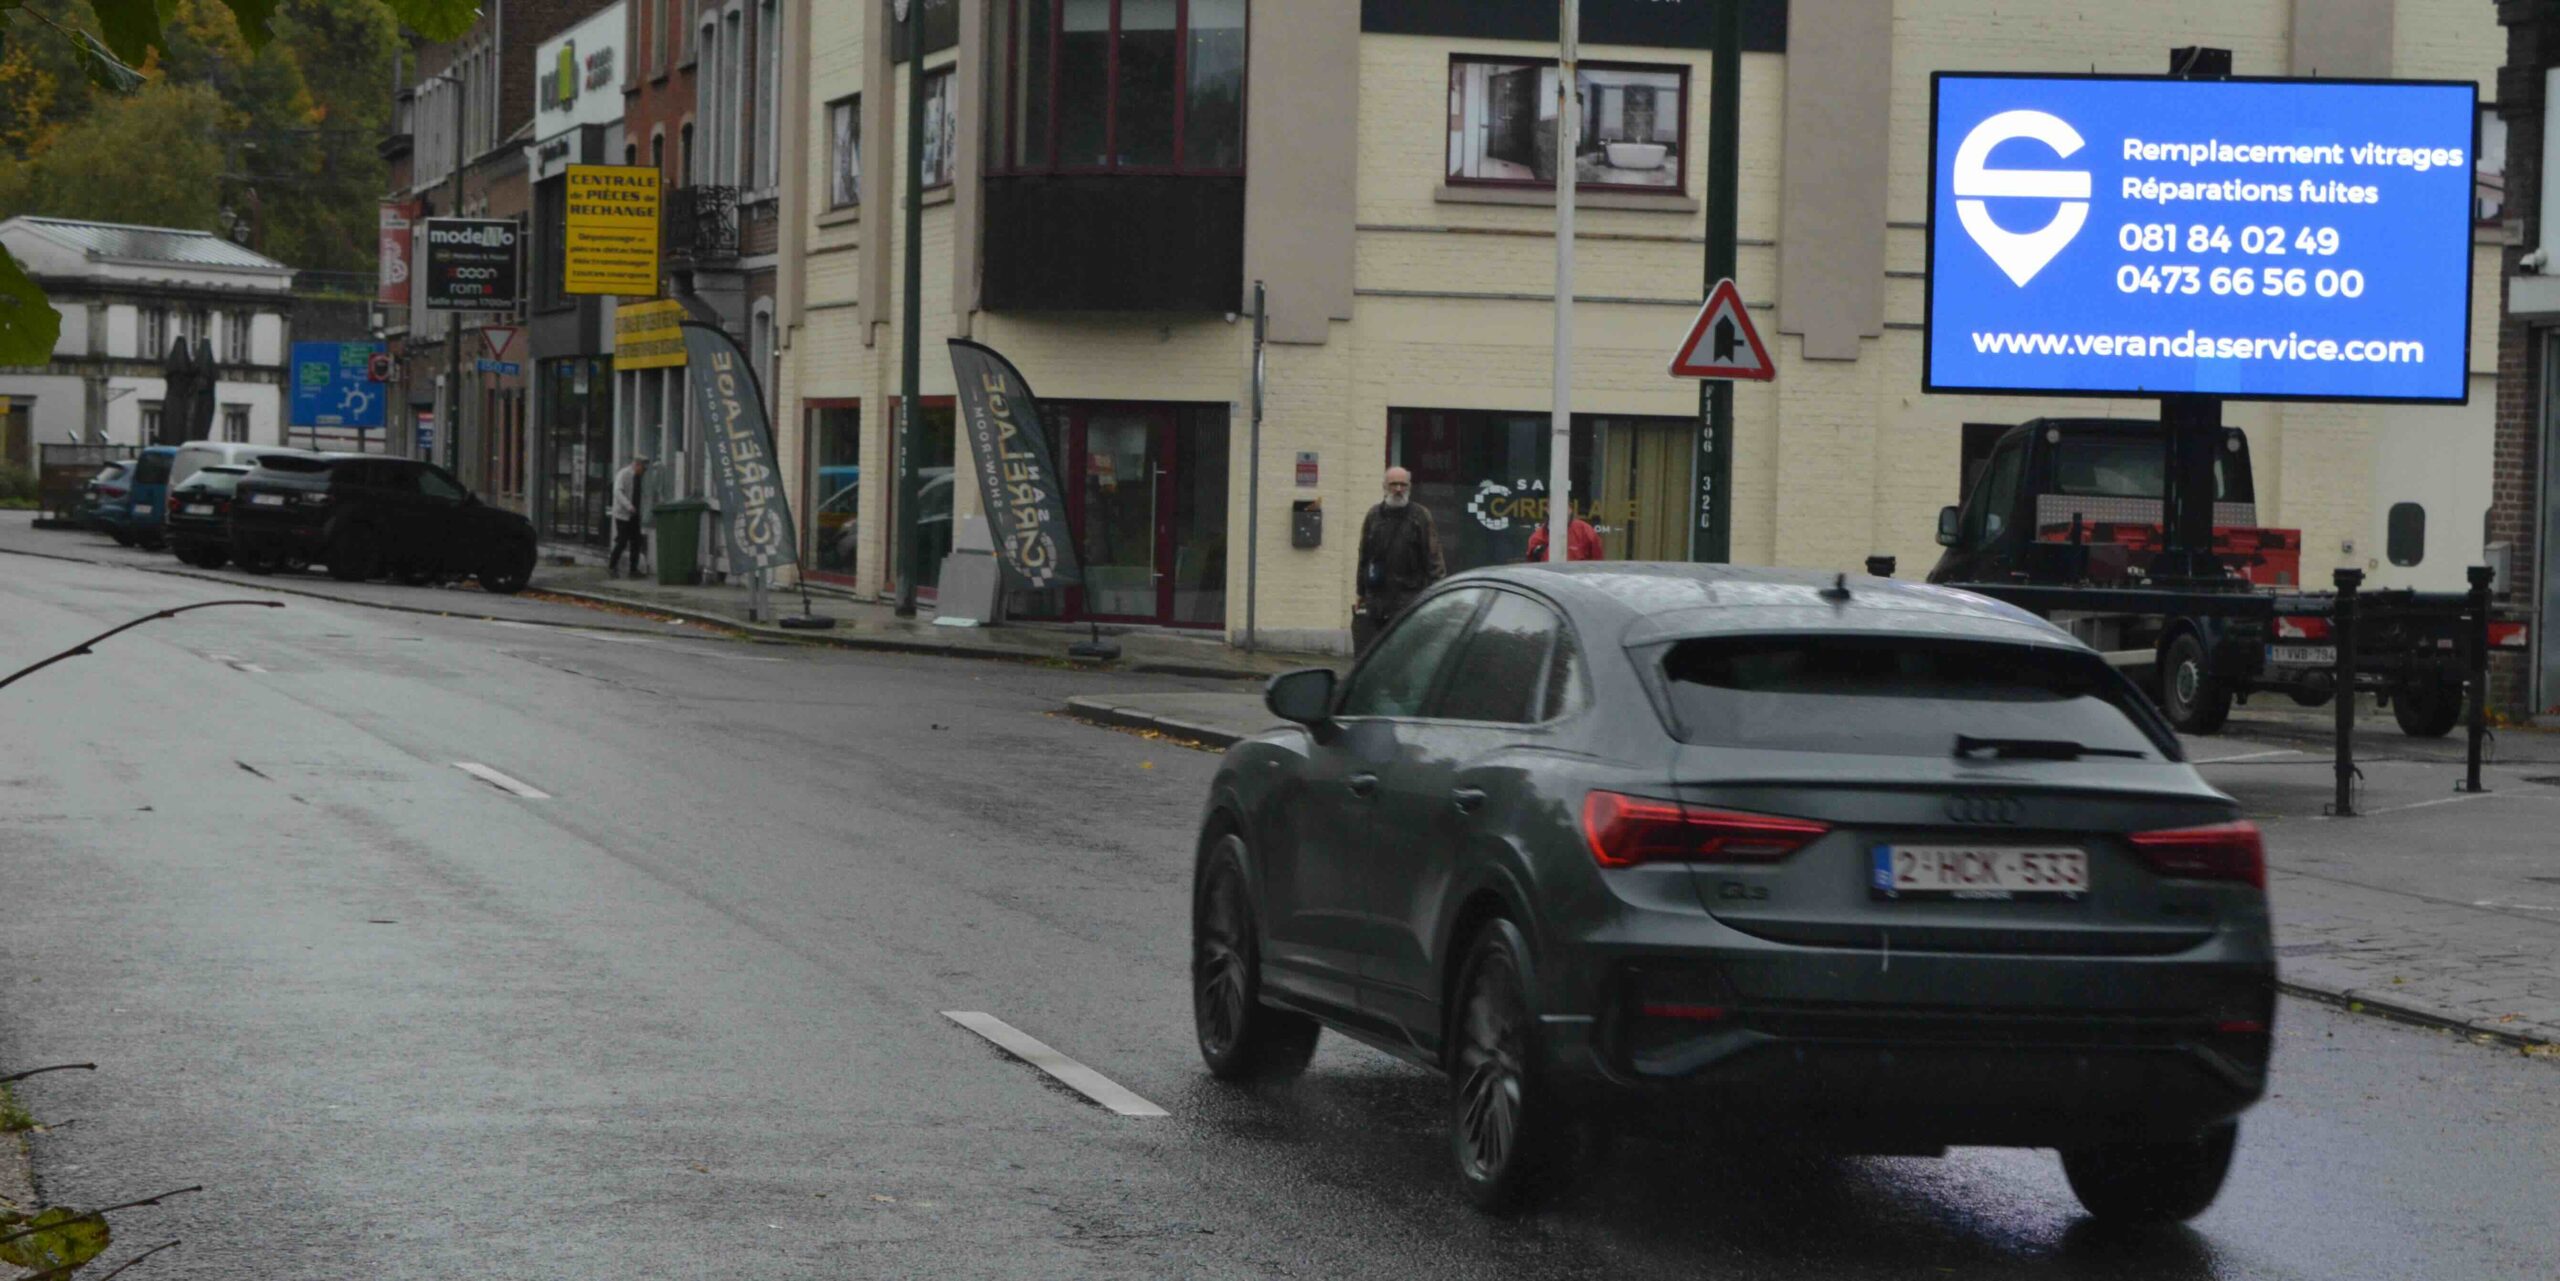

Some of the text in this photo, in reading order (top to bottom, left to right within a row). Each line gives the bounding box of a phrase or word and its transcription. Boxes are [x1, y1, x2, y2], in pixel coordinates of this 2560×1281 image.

[2123, 138, 2464, 172] Remplacement vitrages
[570, 174, 657, 187] CENTRALE
[587, 187, 640, 201] PIÈCES
[2122, 176, 2379, 205] Réparations fuites
[570, 204, 657, 217] RECHANGE
[2119, 223, 2340, 256] 081 84 02 49
[2116, 264, 2365, 298] 0473 66 56 00
[1971, 329, 2424, 363] www.verandaservice.com
[1899, 851, 2083, 885] 2-HCK-533
